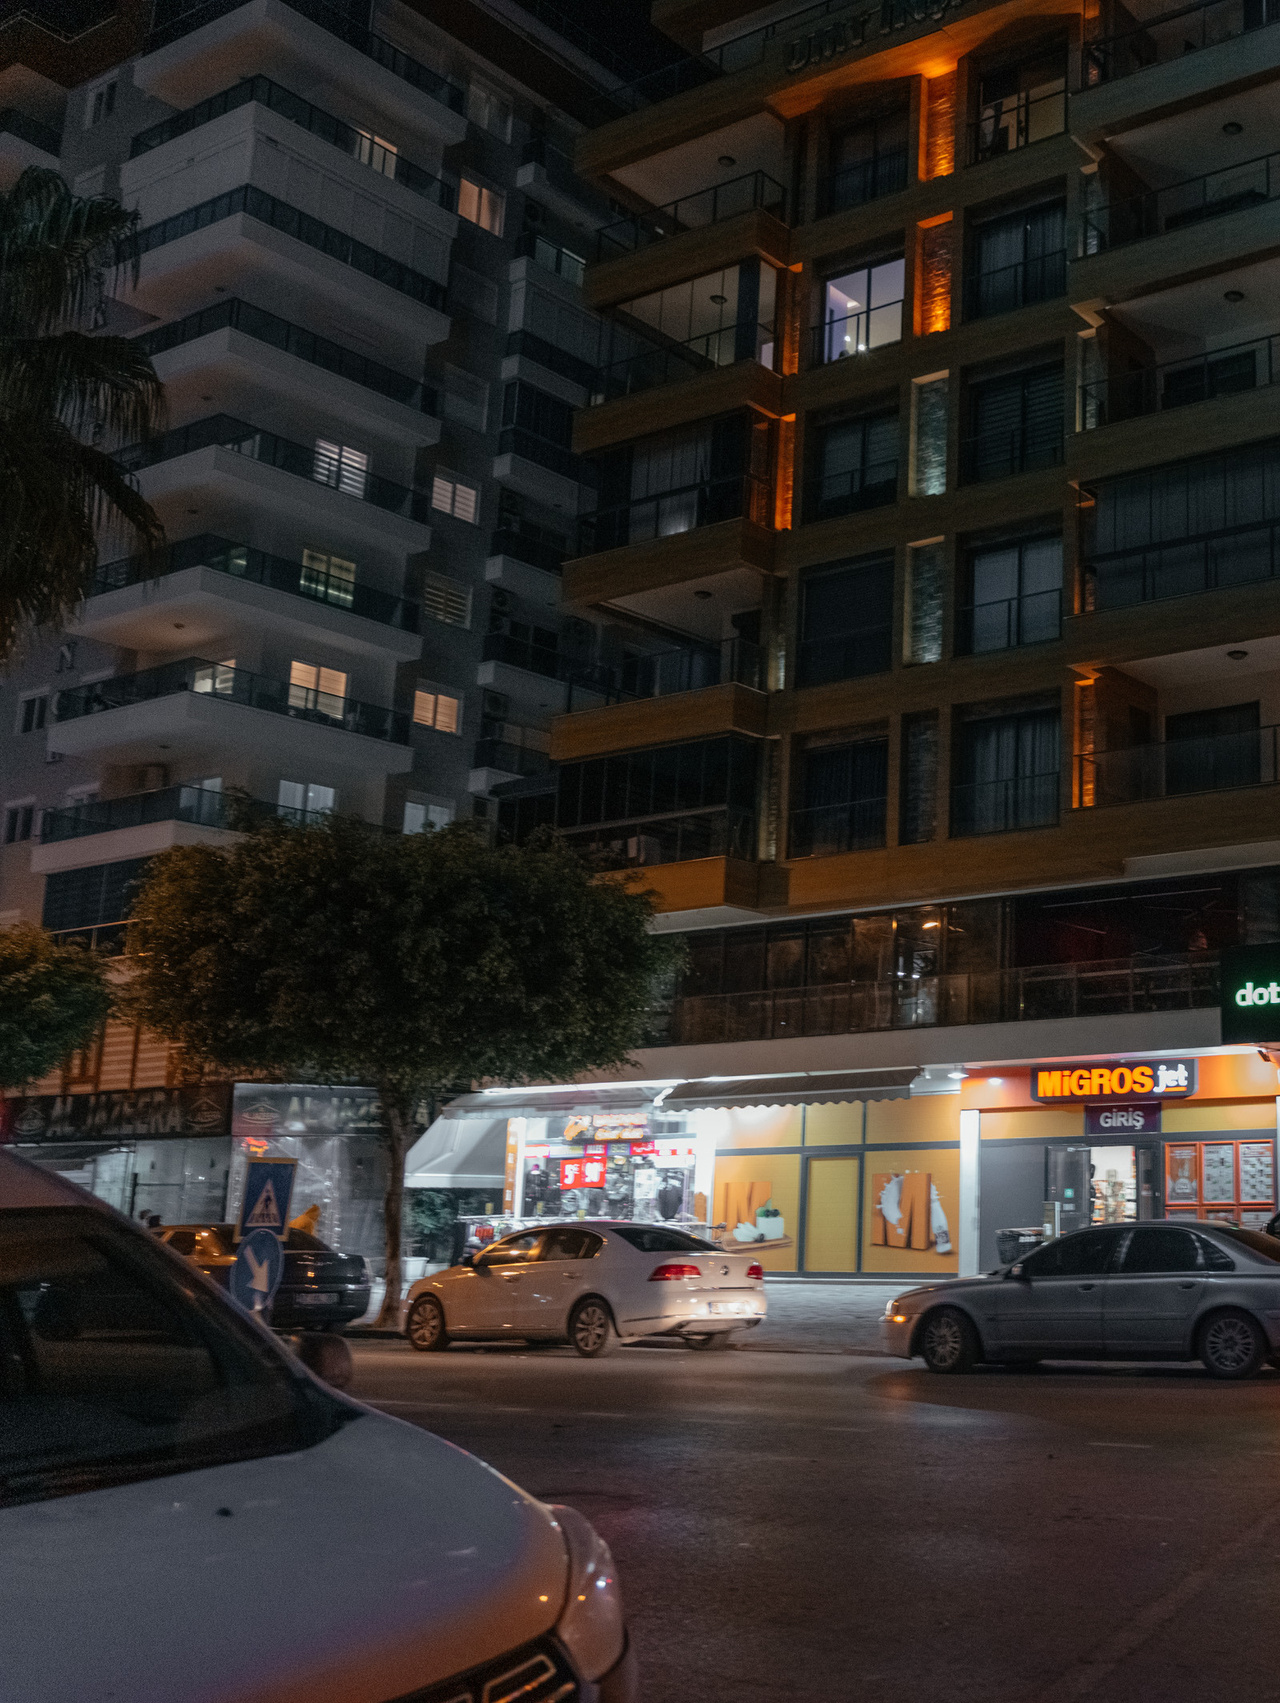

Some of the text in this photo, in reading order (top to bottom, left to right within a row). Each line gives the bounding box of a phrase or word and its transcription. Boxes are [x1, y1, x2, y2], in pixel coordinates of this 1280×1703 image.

[1037, 1064, 1189, 1097] MiGROS jet
[1099, 1108, 1145, 1130] GİRİŞ
